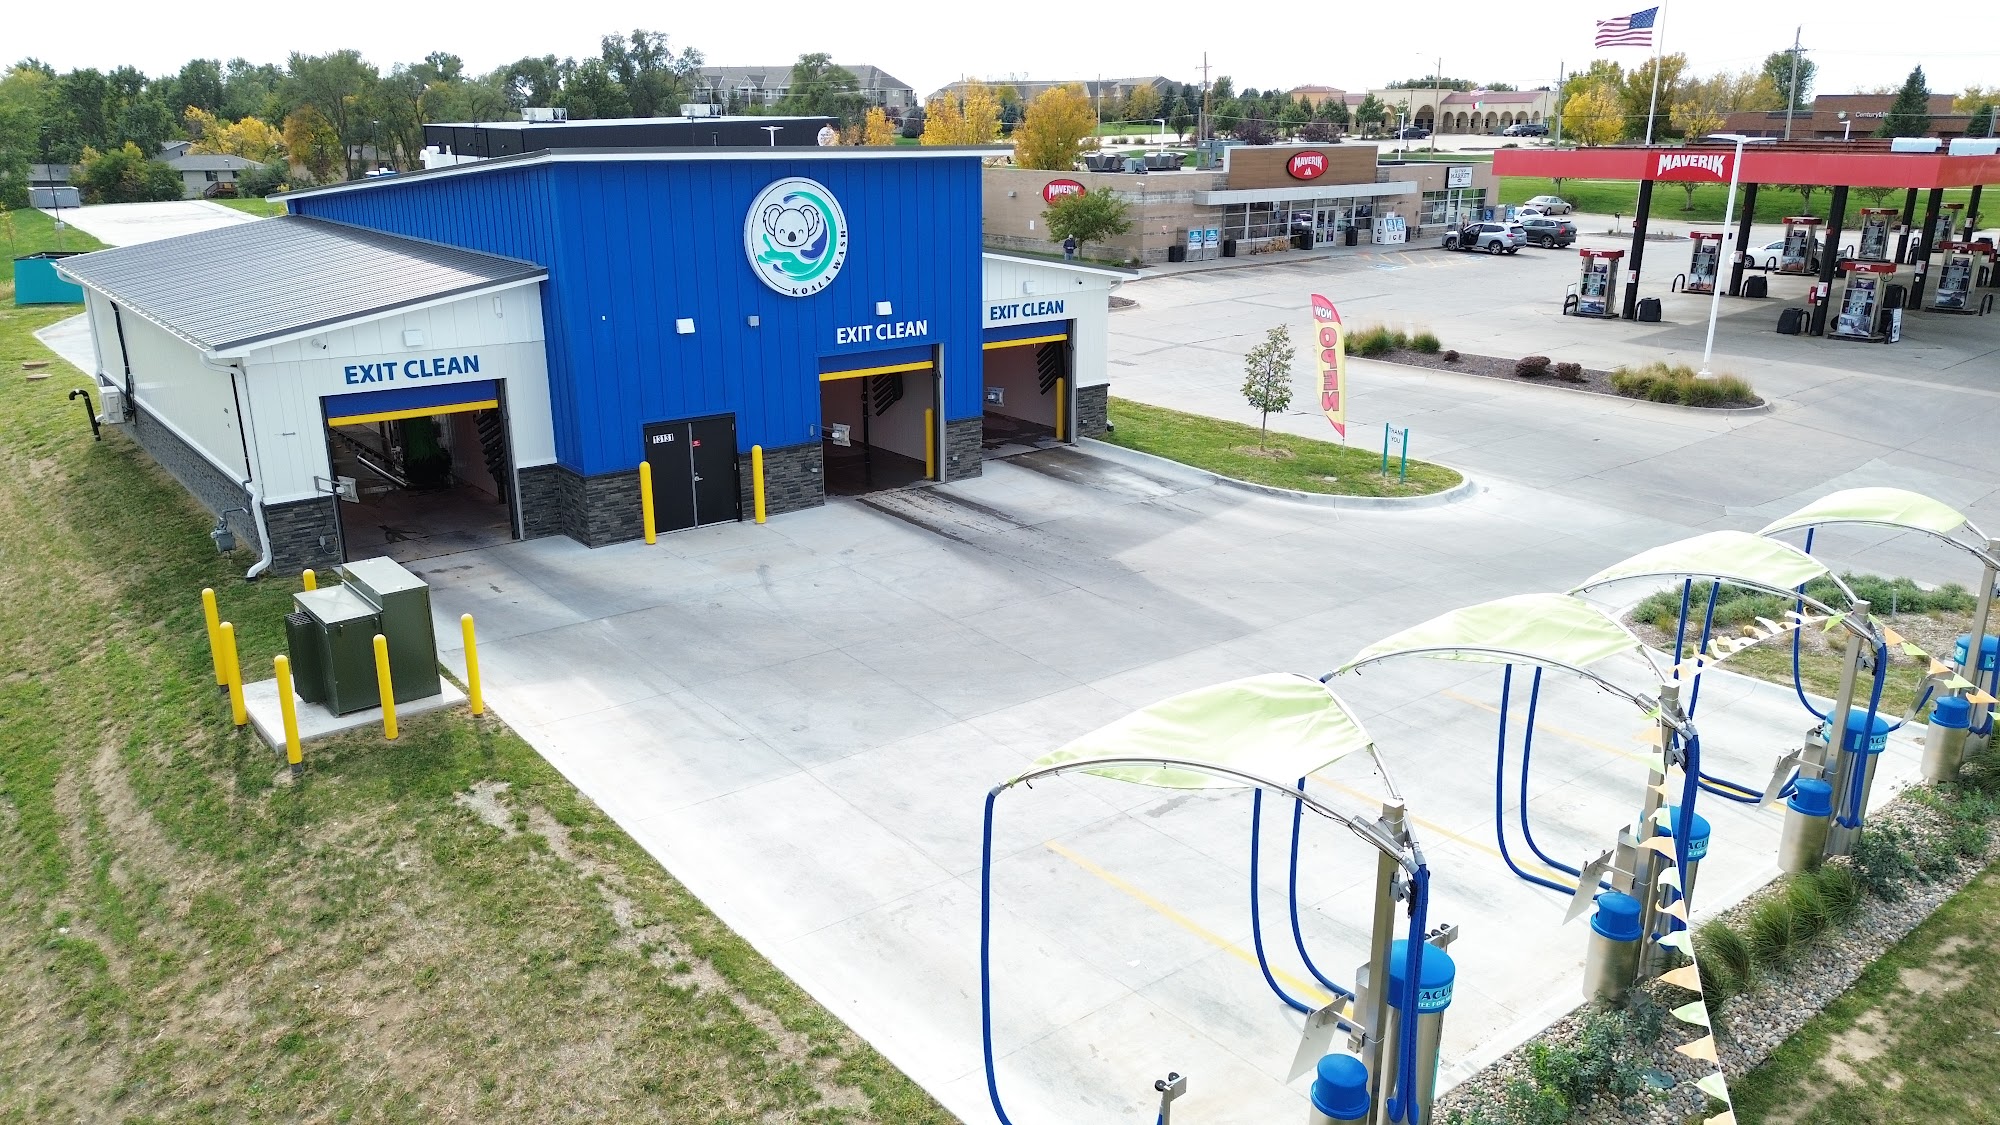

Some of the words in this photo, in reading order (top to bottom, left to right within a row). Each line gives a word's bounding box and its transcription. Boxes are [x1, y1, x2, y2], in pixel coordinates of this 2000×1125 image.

[1293, 155, 1323, 172] MAVERIK
[1657, 154, 1725, 178] MAVERIK
[792, 275, 831, 295] KOALA
[833, 230, 846, 270] WASH
[991, 304, 1019, 320] EXIT
[1022, 300, 1064, 317] CLEAN
[837, 325, 873, 344] EXIT
[875, 320, 928, 341] CLEAN
[344, 362, 398, 384] EXIT
[403, 355, 480, 379] CLEAN
[1389, 427, 1403, 436] THANK
